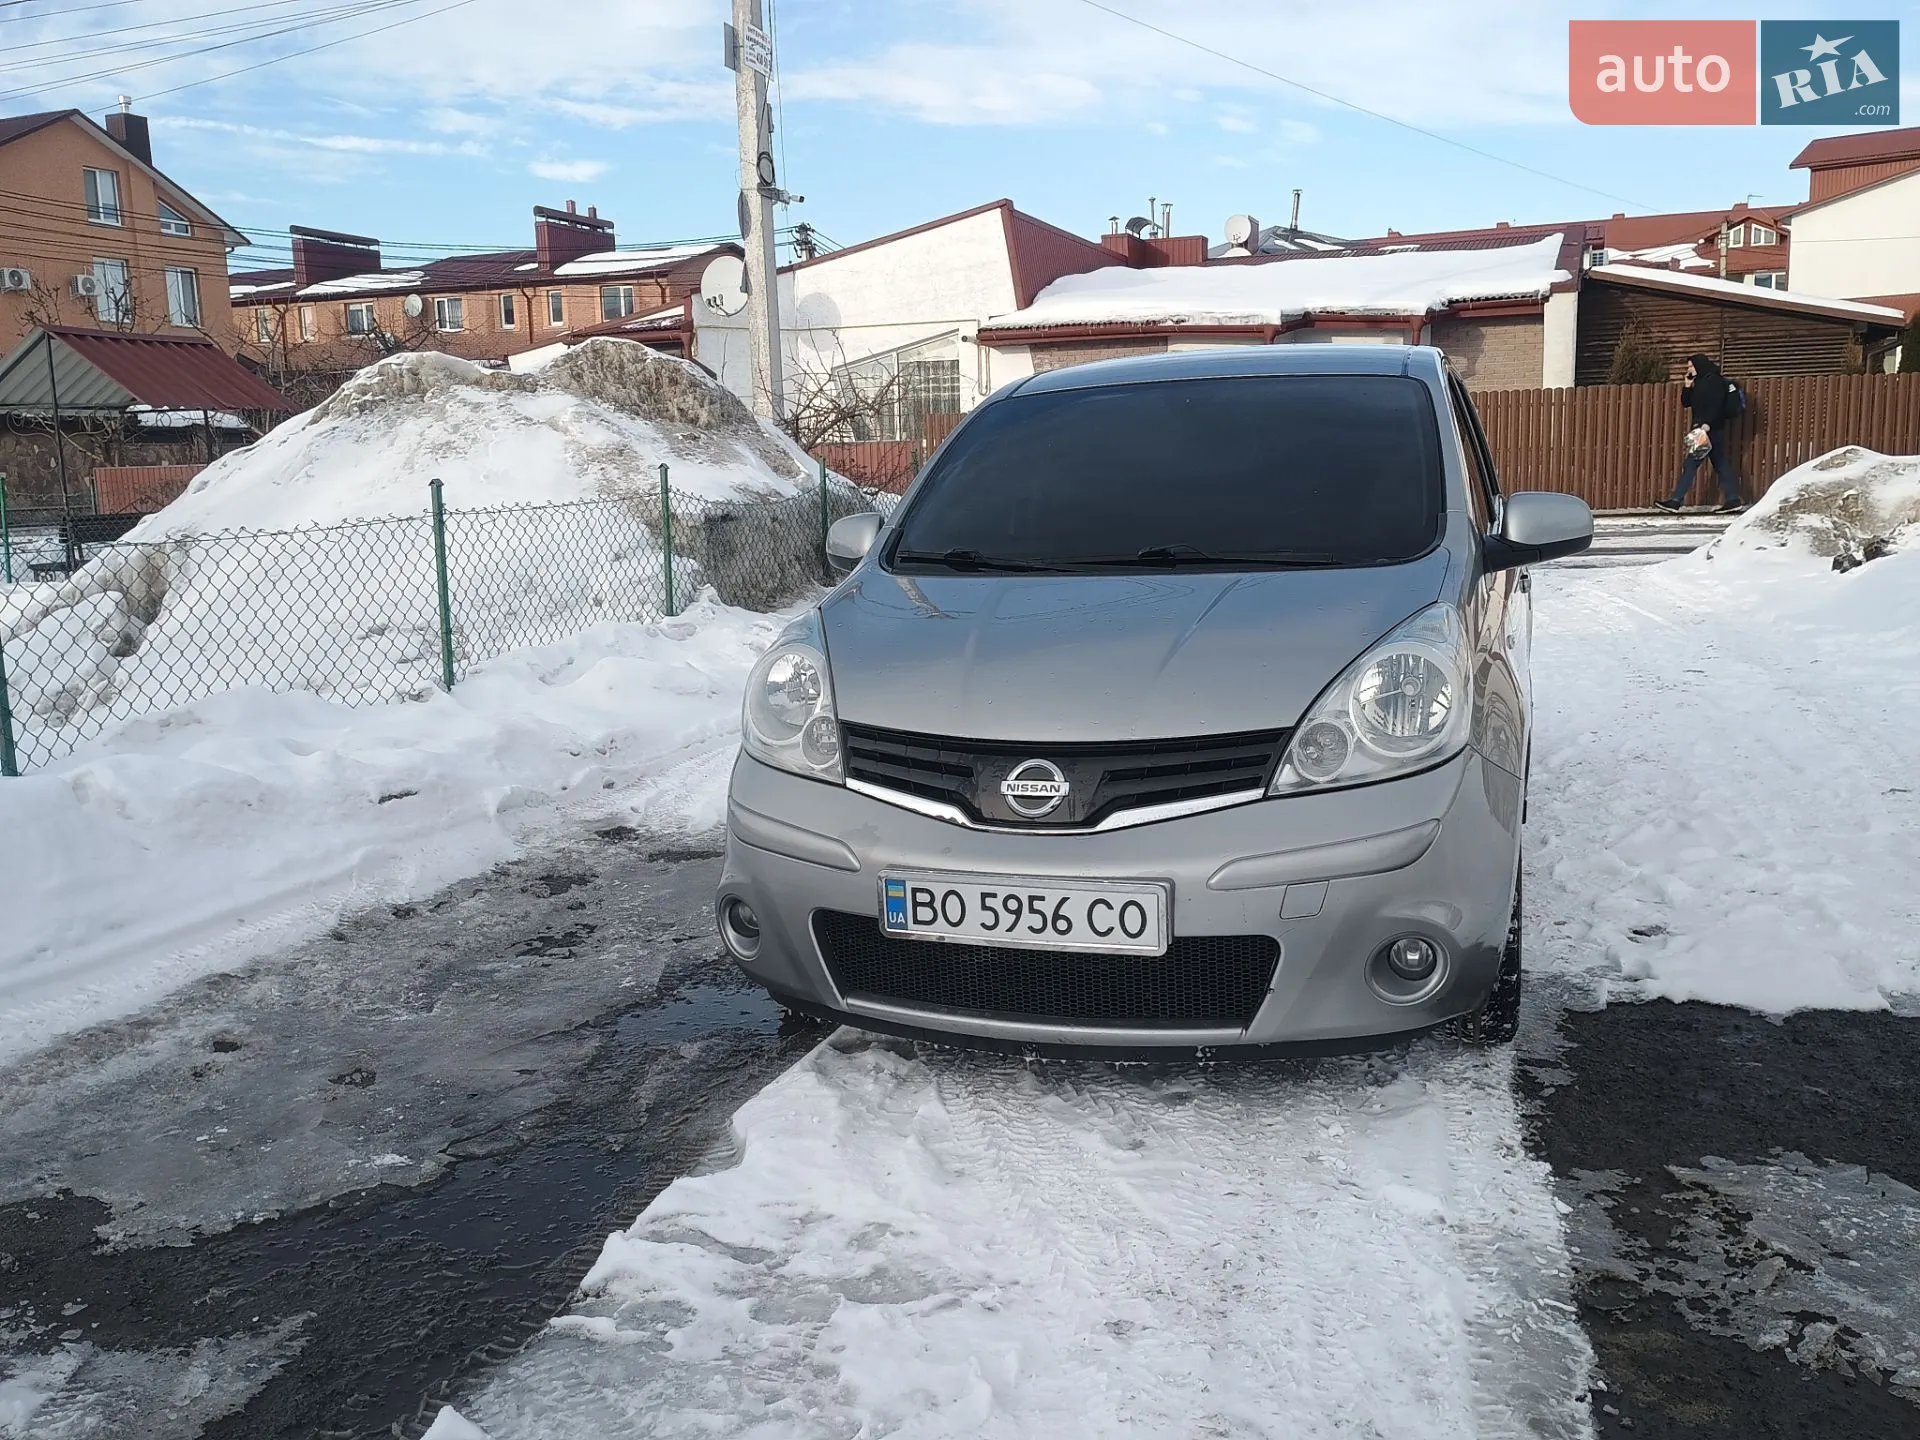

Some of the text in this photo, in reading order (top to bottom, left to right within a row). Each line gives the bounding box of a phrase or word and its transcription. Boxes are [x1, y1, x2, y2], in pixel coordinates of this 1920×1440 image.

[1006, 783, 1060, 793] NISSAN
[888, 911, 906, 924] UA
[911, 887, 1147, 939] BO 5956 CO
